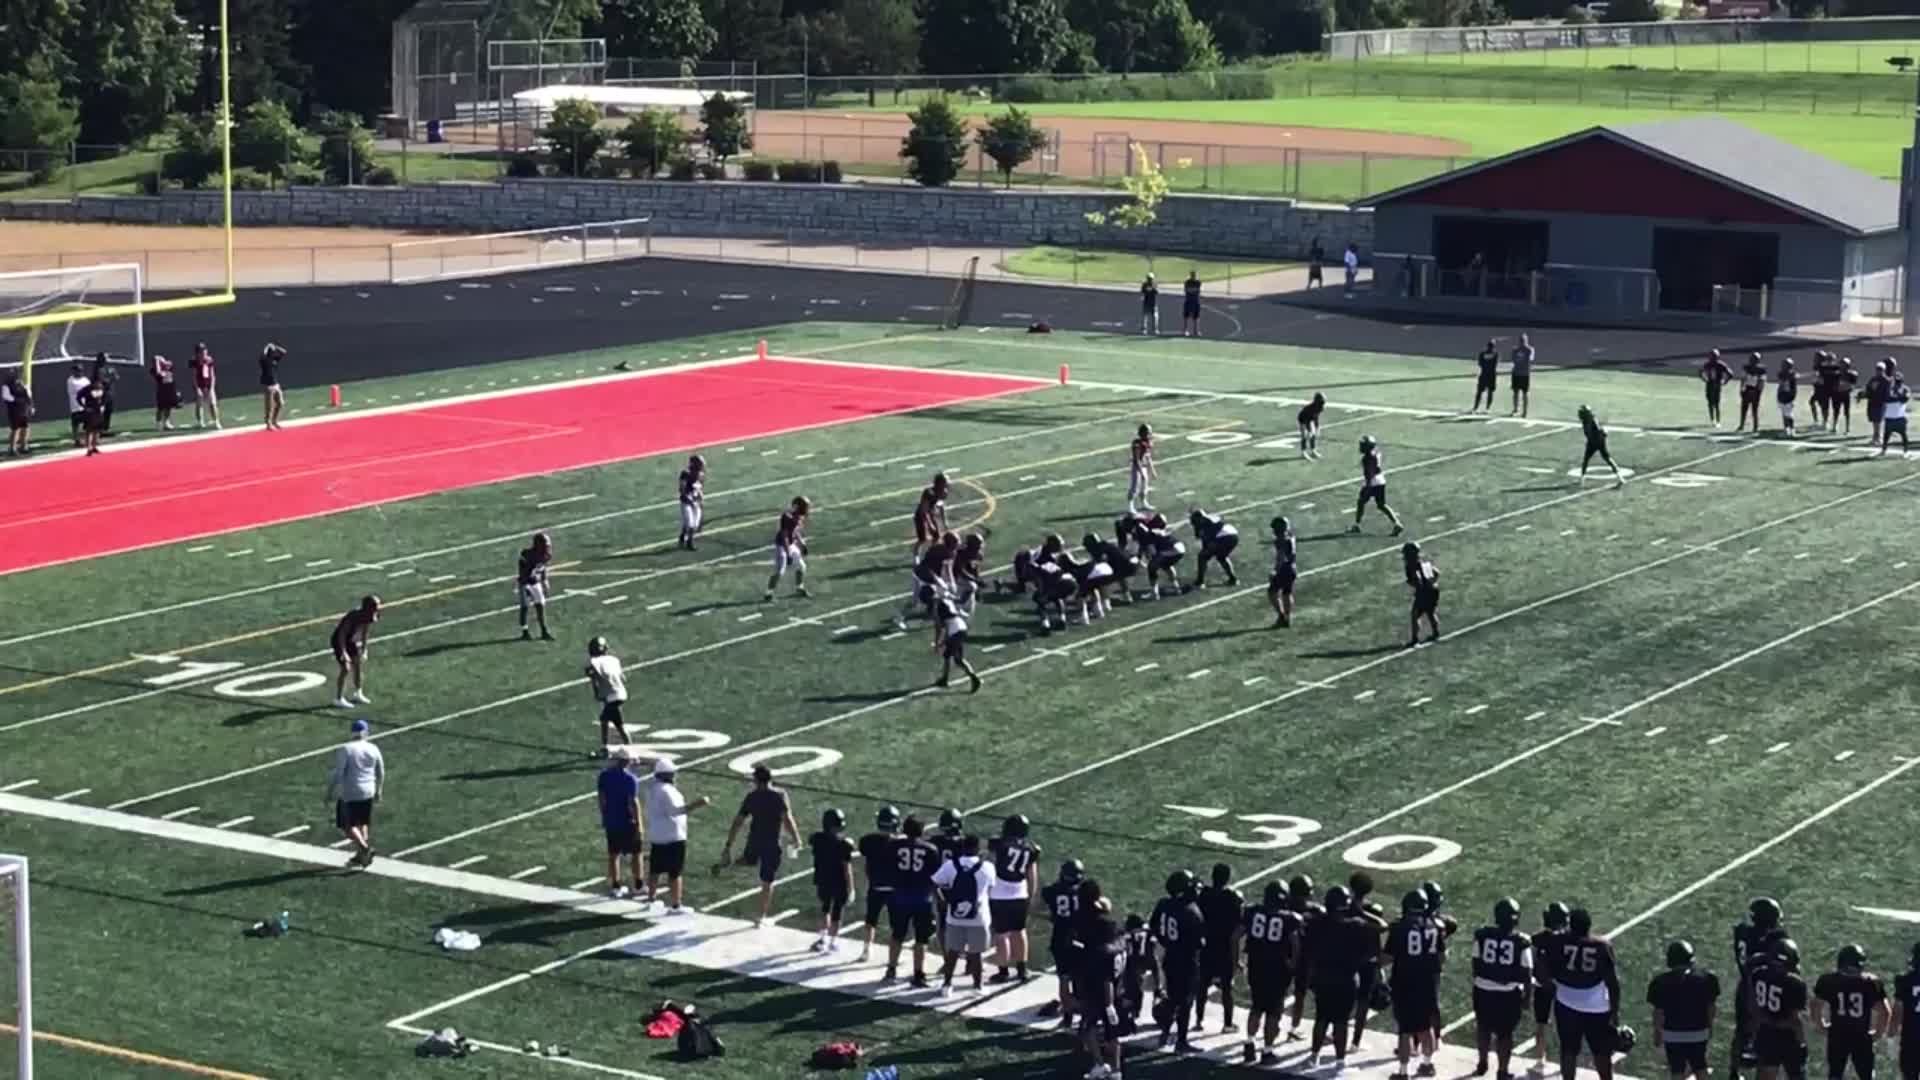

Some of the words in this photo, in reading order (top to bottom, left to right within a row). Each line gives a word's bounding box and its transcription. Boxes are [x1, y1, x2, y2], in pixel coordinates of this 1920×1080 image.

[142, 661, 327, 697] 10
[607, 728, 844, 776] 20
[1201, 814, 1463, 871] 30
[897, 847, 926, 872] 35
[1007, 847, 1030, 873] 71
[1251, 914, 1284, 942] 68
[1407, 928, 1439, 956] 87
[1482, 937, 1515, 965] 63
[1563, 944, 1598, 973] 75
[1837, 992, 1864, 1018] 13
